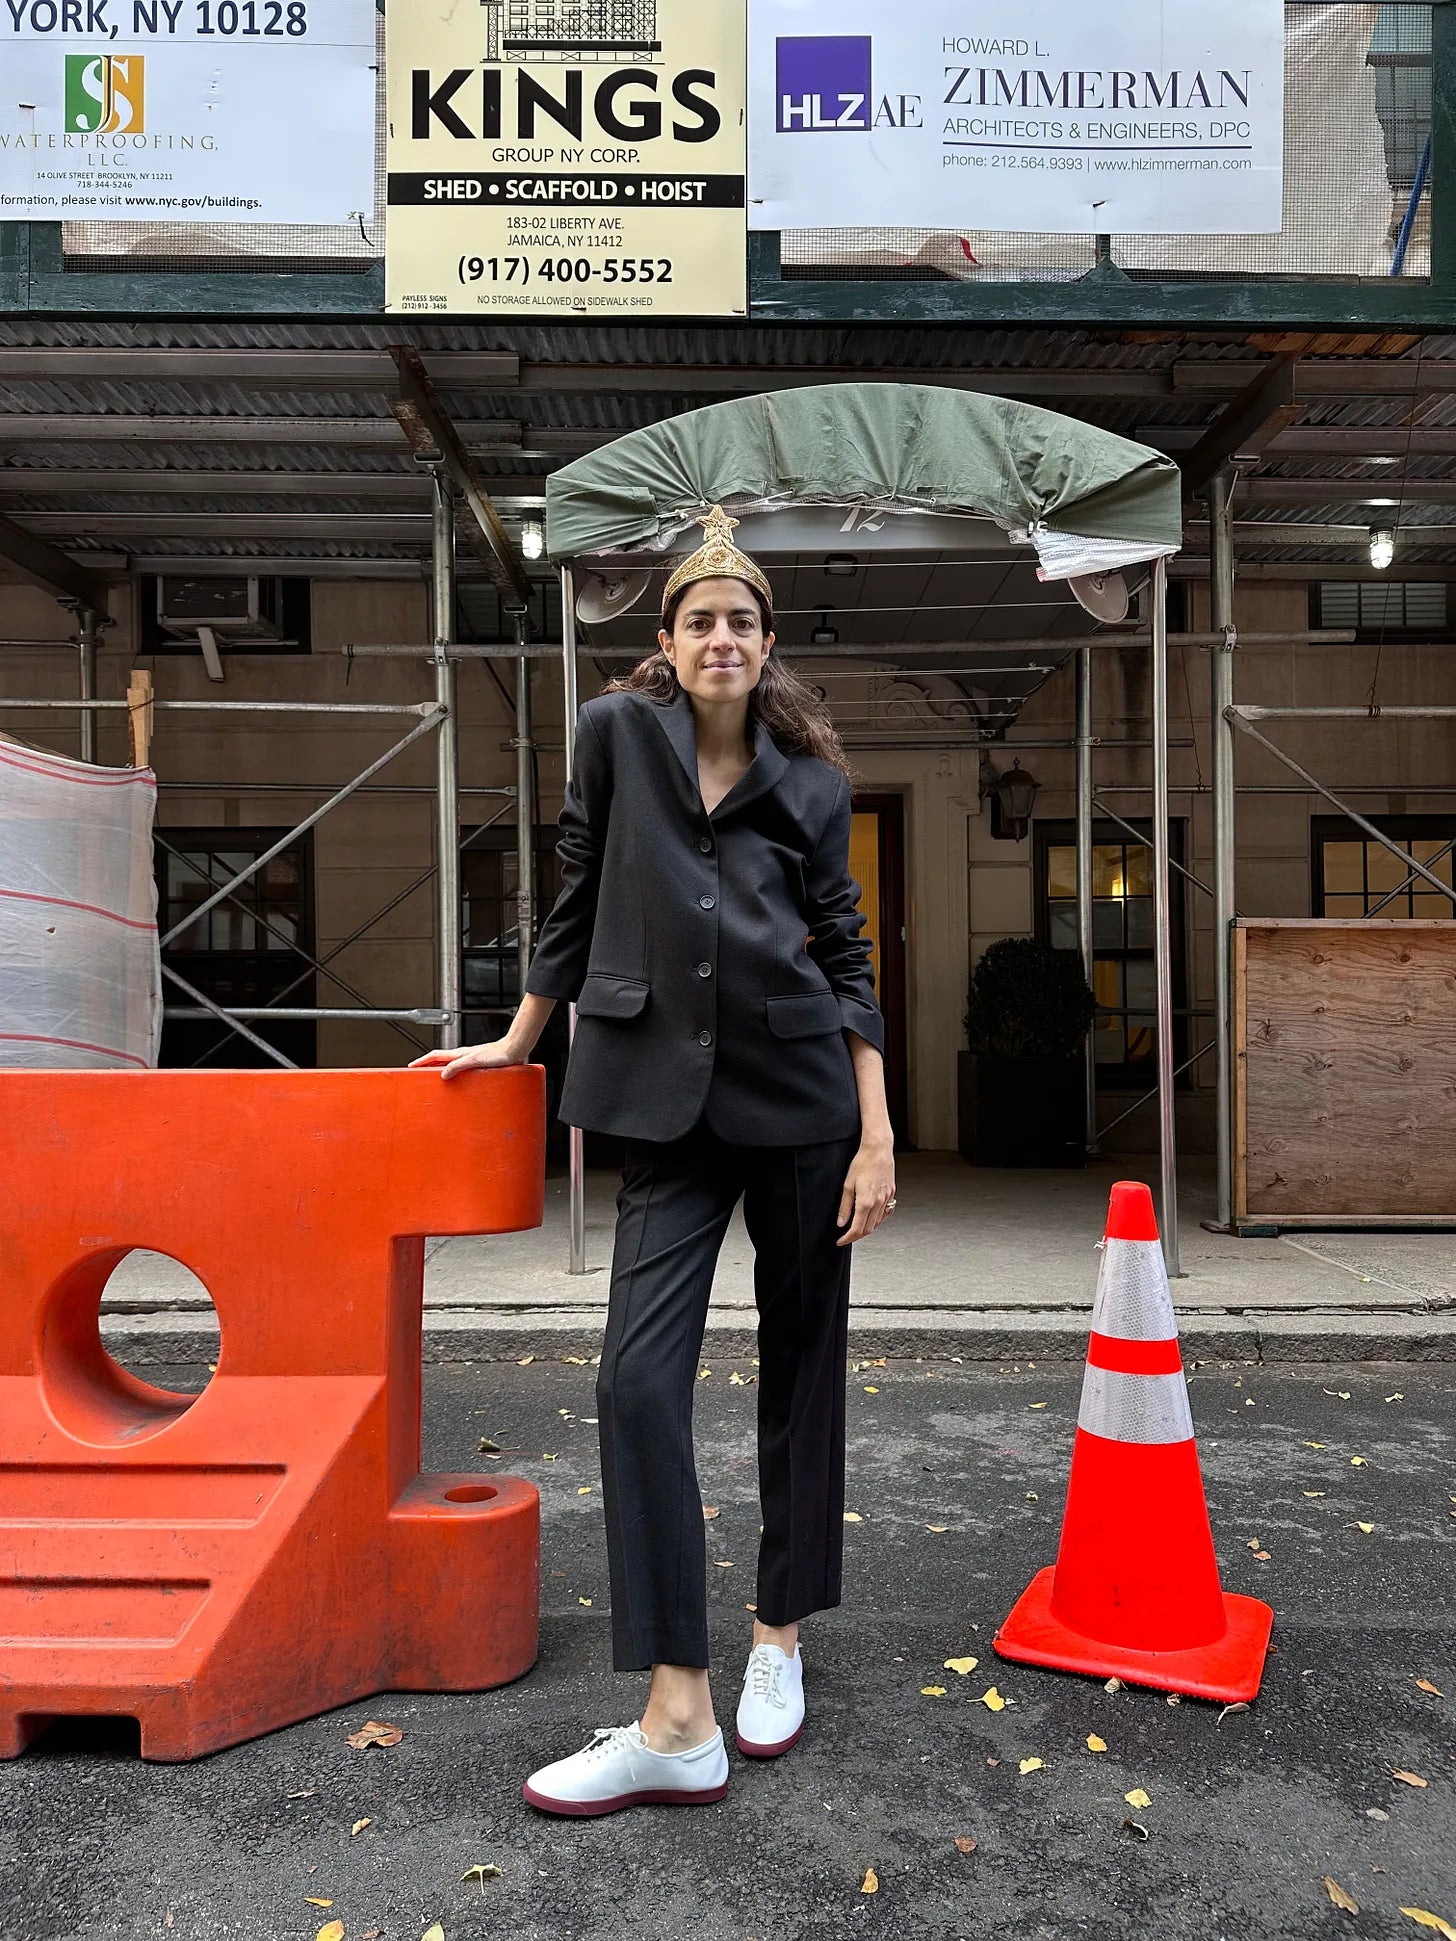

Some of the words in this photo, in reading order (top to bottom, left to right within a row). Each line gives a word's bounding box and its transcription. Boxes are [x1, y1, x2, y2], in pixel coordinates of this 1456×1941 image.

[10, 0, 118, 39] YORK,
[133, 0, 183, 34] NY
[196, 0, 307, 37] 10128
[942, 36, 1029, 57] HOWARD
[1035, 39, 1050, 57] L.
[943, 66, 1253, 109] ZIMMERMAN
[411, 67, 721, 143] KINGS
[942, 118, 1063, 139] ARCHITECTS
[1068, 121, 1082, 139] &
[1087, 121, 1203, 141] ENGINEERS,
[1209, 121, 1251, 139] DPC
[87, 153, 128, 167] LLC.
[491, 148, 554, 163] GROUP
[560, 148, 585, 163] NY
[590, 149, 640, 164] CORP.
[942, 153, 987, 169] phone:
[991, 155, 1083, 171] 212.564.9393
[1094, 157, 1252, 171] www.hlzimmerman.com
[37, 171, 45, 179] 14
[69, 172, 94, 180] STREET
[97, 172, 138, 181] BROOKLYN,
[77, 181, 133, 189] 718-344-5246
[424, 179, 483, 200] SHED
[505, 179, 618, 200] SCAFFOLD
[641, 180, 707, 201] HOIST
[61, 194, 97, 207] please
[99, 194, 122, 205] visit
[125, 195, 262, 209] www.nyc.gov/buildings.
[506, 217, 547, 230] 183-02
[550, 217, 595, 230] LIBERTY
[598, 217, 625, 230] AVE.
[507, 234, 564, 248] JAMAICA,
[567, 235, 584, 247] NY
[586, 235, 623, 248] 11412
[458, 255, 530, 286] (917)
[537, 257, 673, 283] 400-5552
[401, 294, 427, 302] PAYLESS
[477, 295, 490, 304] NO
[491, 295, 531, 305] STORAGE
[531, 296, 572, 305] ALLOWED
[573, 297, 586, 306] ON
[587, 297, 628, 306] SIDEWALK
[630, 297, 653, 306] SHED
